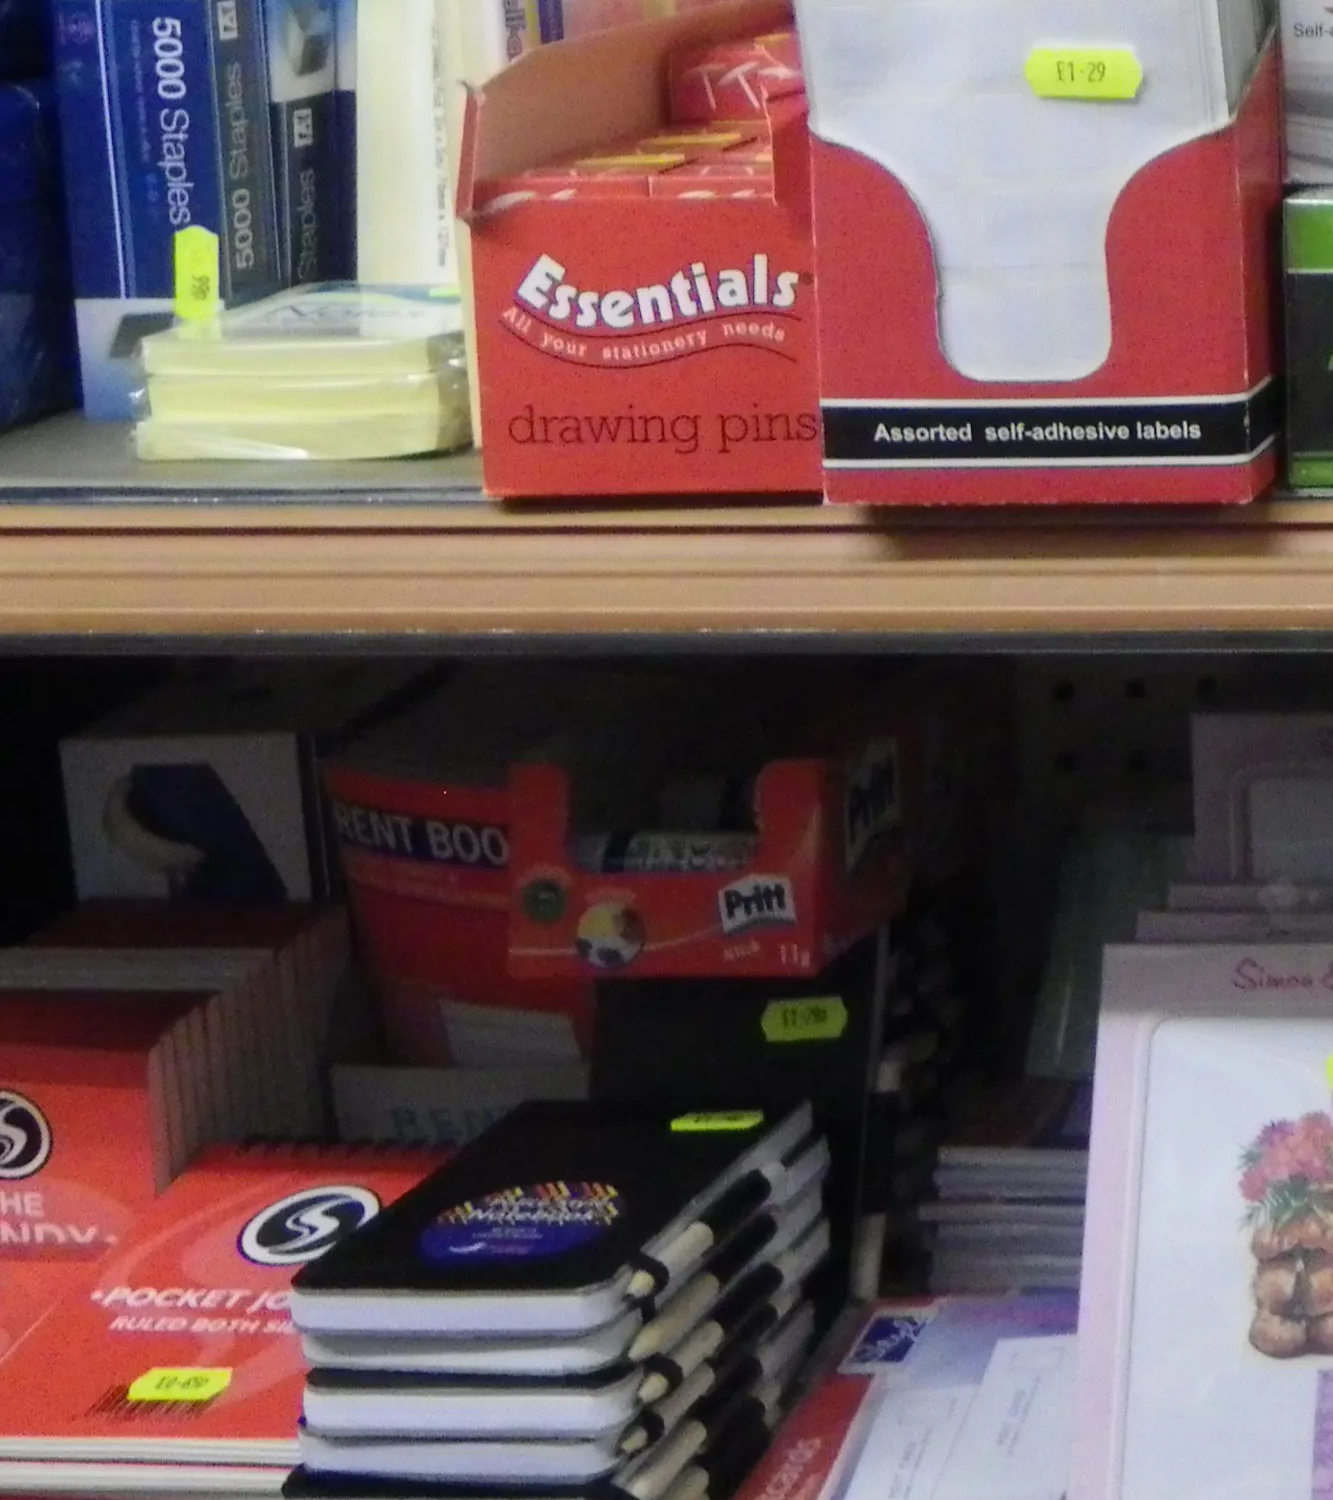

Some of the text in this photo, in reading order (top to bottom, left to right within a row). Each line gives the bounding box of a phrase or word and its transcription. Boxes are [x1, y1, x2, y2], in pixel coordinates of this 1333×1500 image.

[152, 17, 193, 226] 5000 Staples
[226, 61, 255, 270] 5000 Staples
[517, 254, 799, 329] Essentials
[503, 306, 787, 361] All your stationery needs
[508, 402, 818, 455] drawing pins
[874, 420, 1202, 443] Assorted self-adhesive labels
[724, 884, 786, 919] Pritt
[103, 1286, 243, 1308] POCKET
[109, 1315, 188, 1332] RULED
[190, 1317, 261, 1332] BOTH
